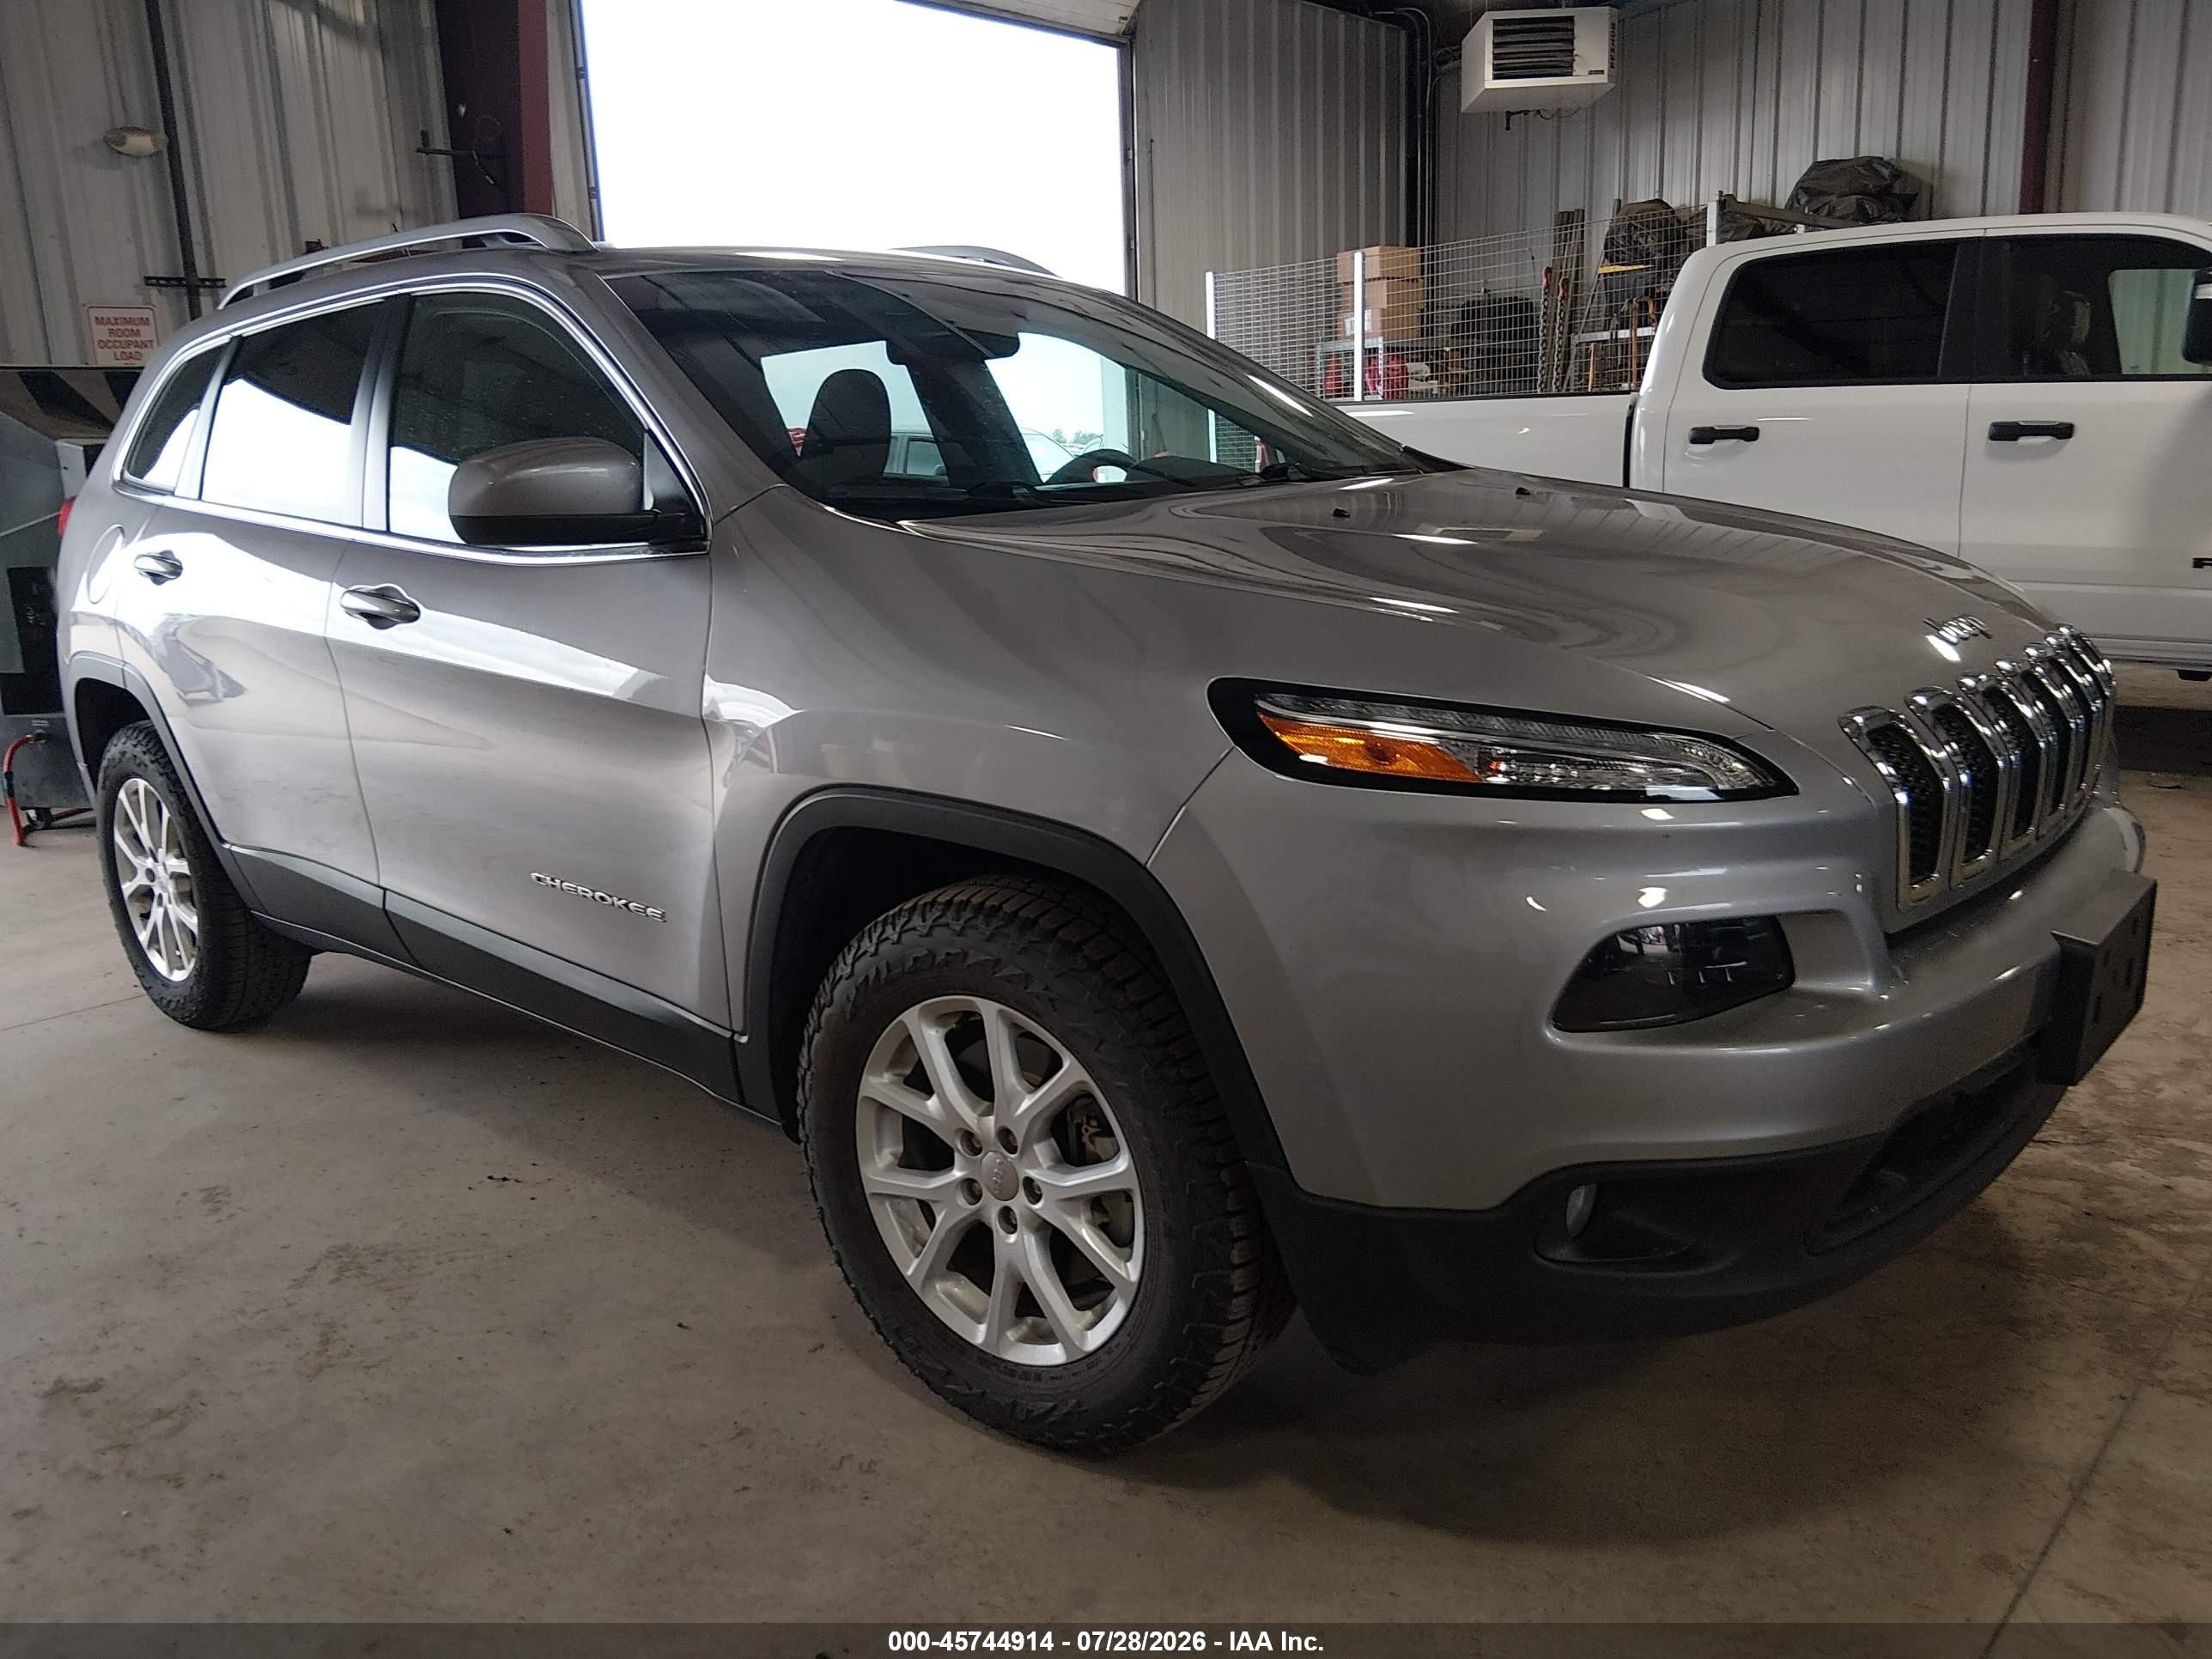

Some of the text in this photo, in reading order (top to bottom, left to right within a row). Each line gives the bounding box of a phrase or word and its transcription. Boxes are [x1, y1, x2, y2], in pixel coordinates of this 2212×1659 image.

[94, 316, 150, 325] MAXIMUM
[108, 328, 141, 337] ROOM
[97, 339, 154, 349] OCCUPANT
[113, 350, 143, 361] LOAD
[530, 872, 666, 922] CHEROKEE
